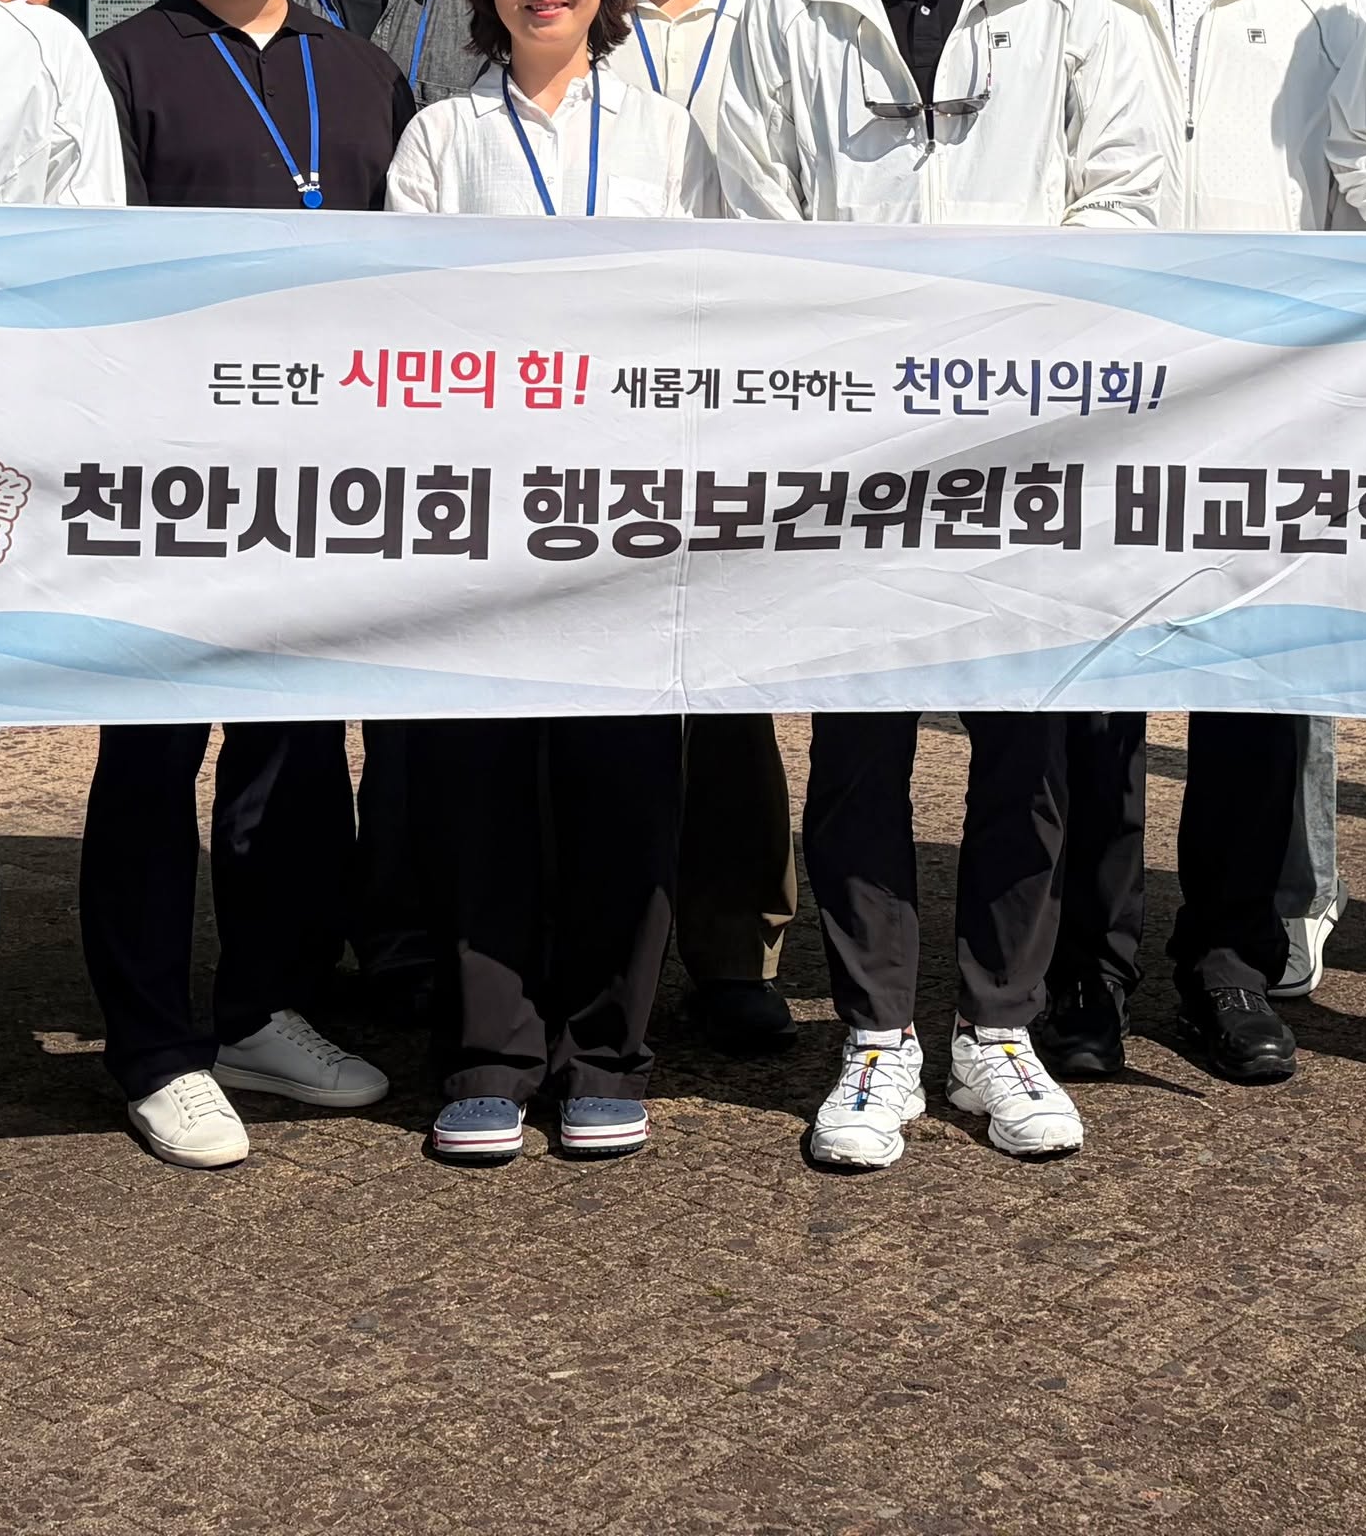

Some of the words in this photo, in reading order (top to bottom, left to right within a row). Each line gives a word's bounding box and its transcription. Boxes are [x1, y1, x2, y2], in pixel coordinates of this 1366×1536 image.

[208, 362, 324, 406] 든든한
[339, 348, 496, 410] 시민의
[517, 350, 590, 410] 힘!
[611, 367, 720, 410] 새롭게
[732, 368, 876, 413] 도약하는
[893, 356, 1167, 416] 천안시의회!
[61, 463, 491, 561] 천안시의회
[523, 462, 1085, 562] 행정보건위원회
